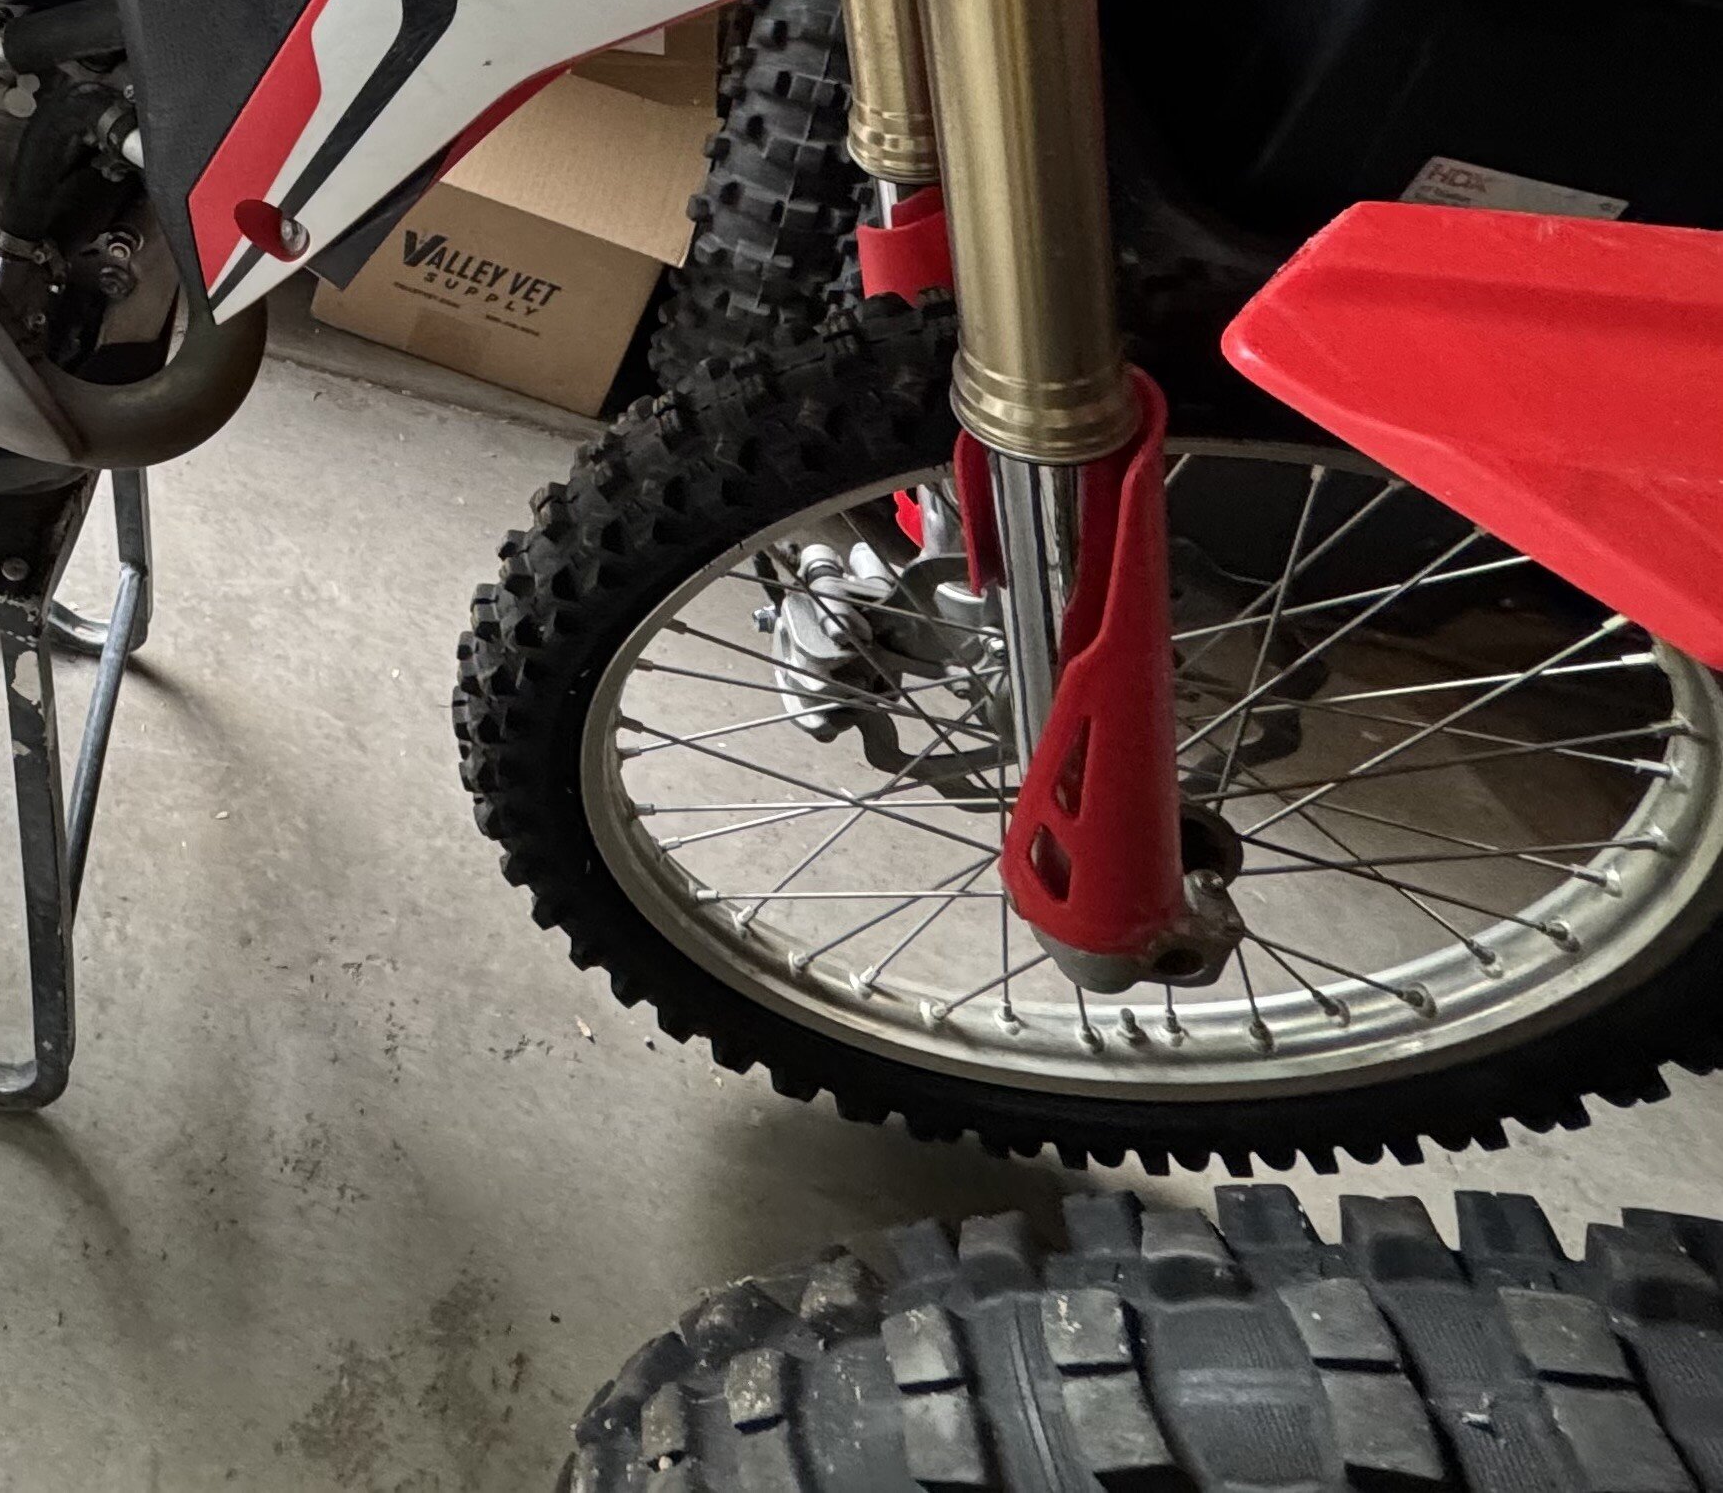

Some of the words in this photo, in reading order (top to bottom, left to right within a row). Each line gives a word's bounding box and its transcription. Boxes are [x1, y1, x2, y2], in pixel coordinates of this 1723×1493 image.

[402, 229, 510, 289] VALLEY
[508, 272, 562, 307] VET
[423, 271, 539, 317] SUPPLY
